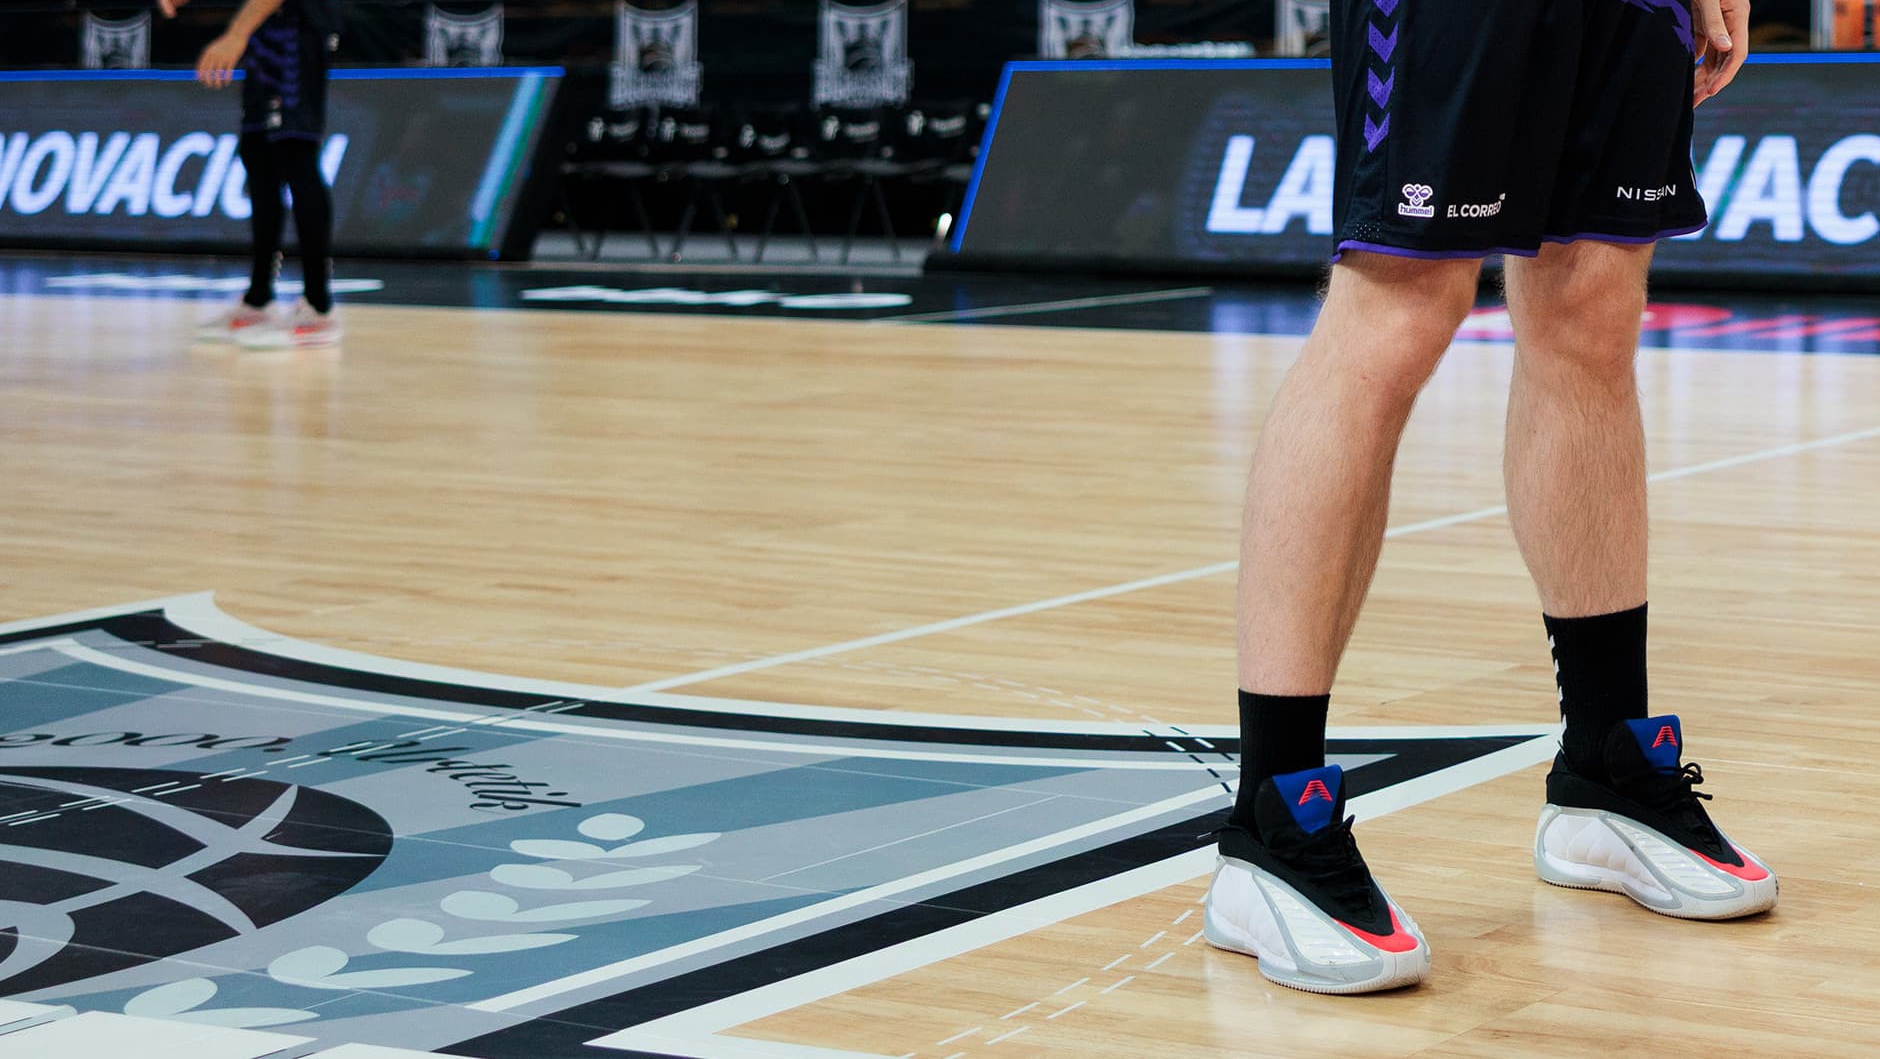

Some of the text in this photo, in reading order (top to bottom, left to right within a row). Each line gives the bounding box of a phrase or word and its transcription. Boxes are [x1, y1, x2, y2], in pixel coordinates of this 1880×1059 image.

[1205, 133, 1338, 235] LA
[1616, 183, 1677, 201] NISSAN
[1447, 200, 1502, 218] EL CORREO
